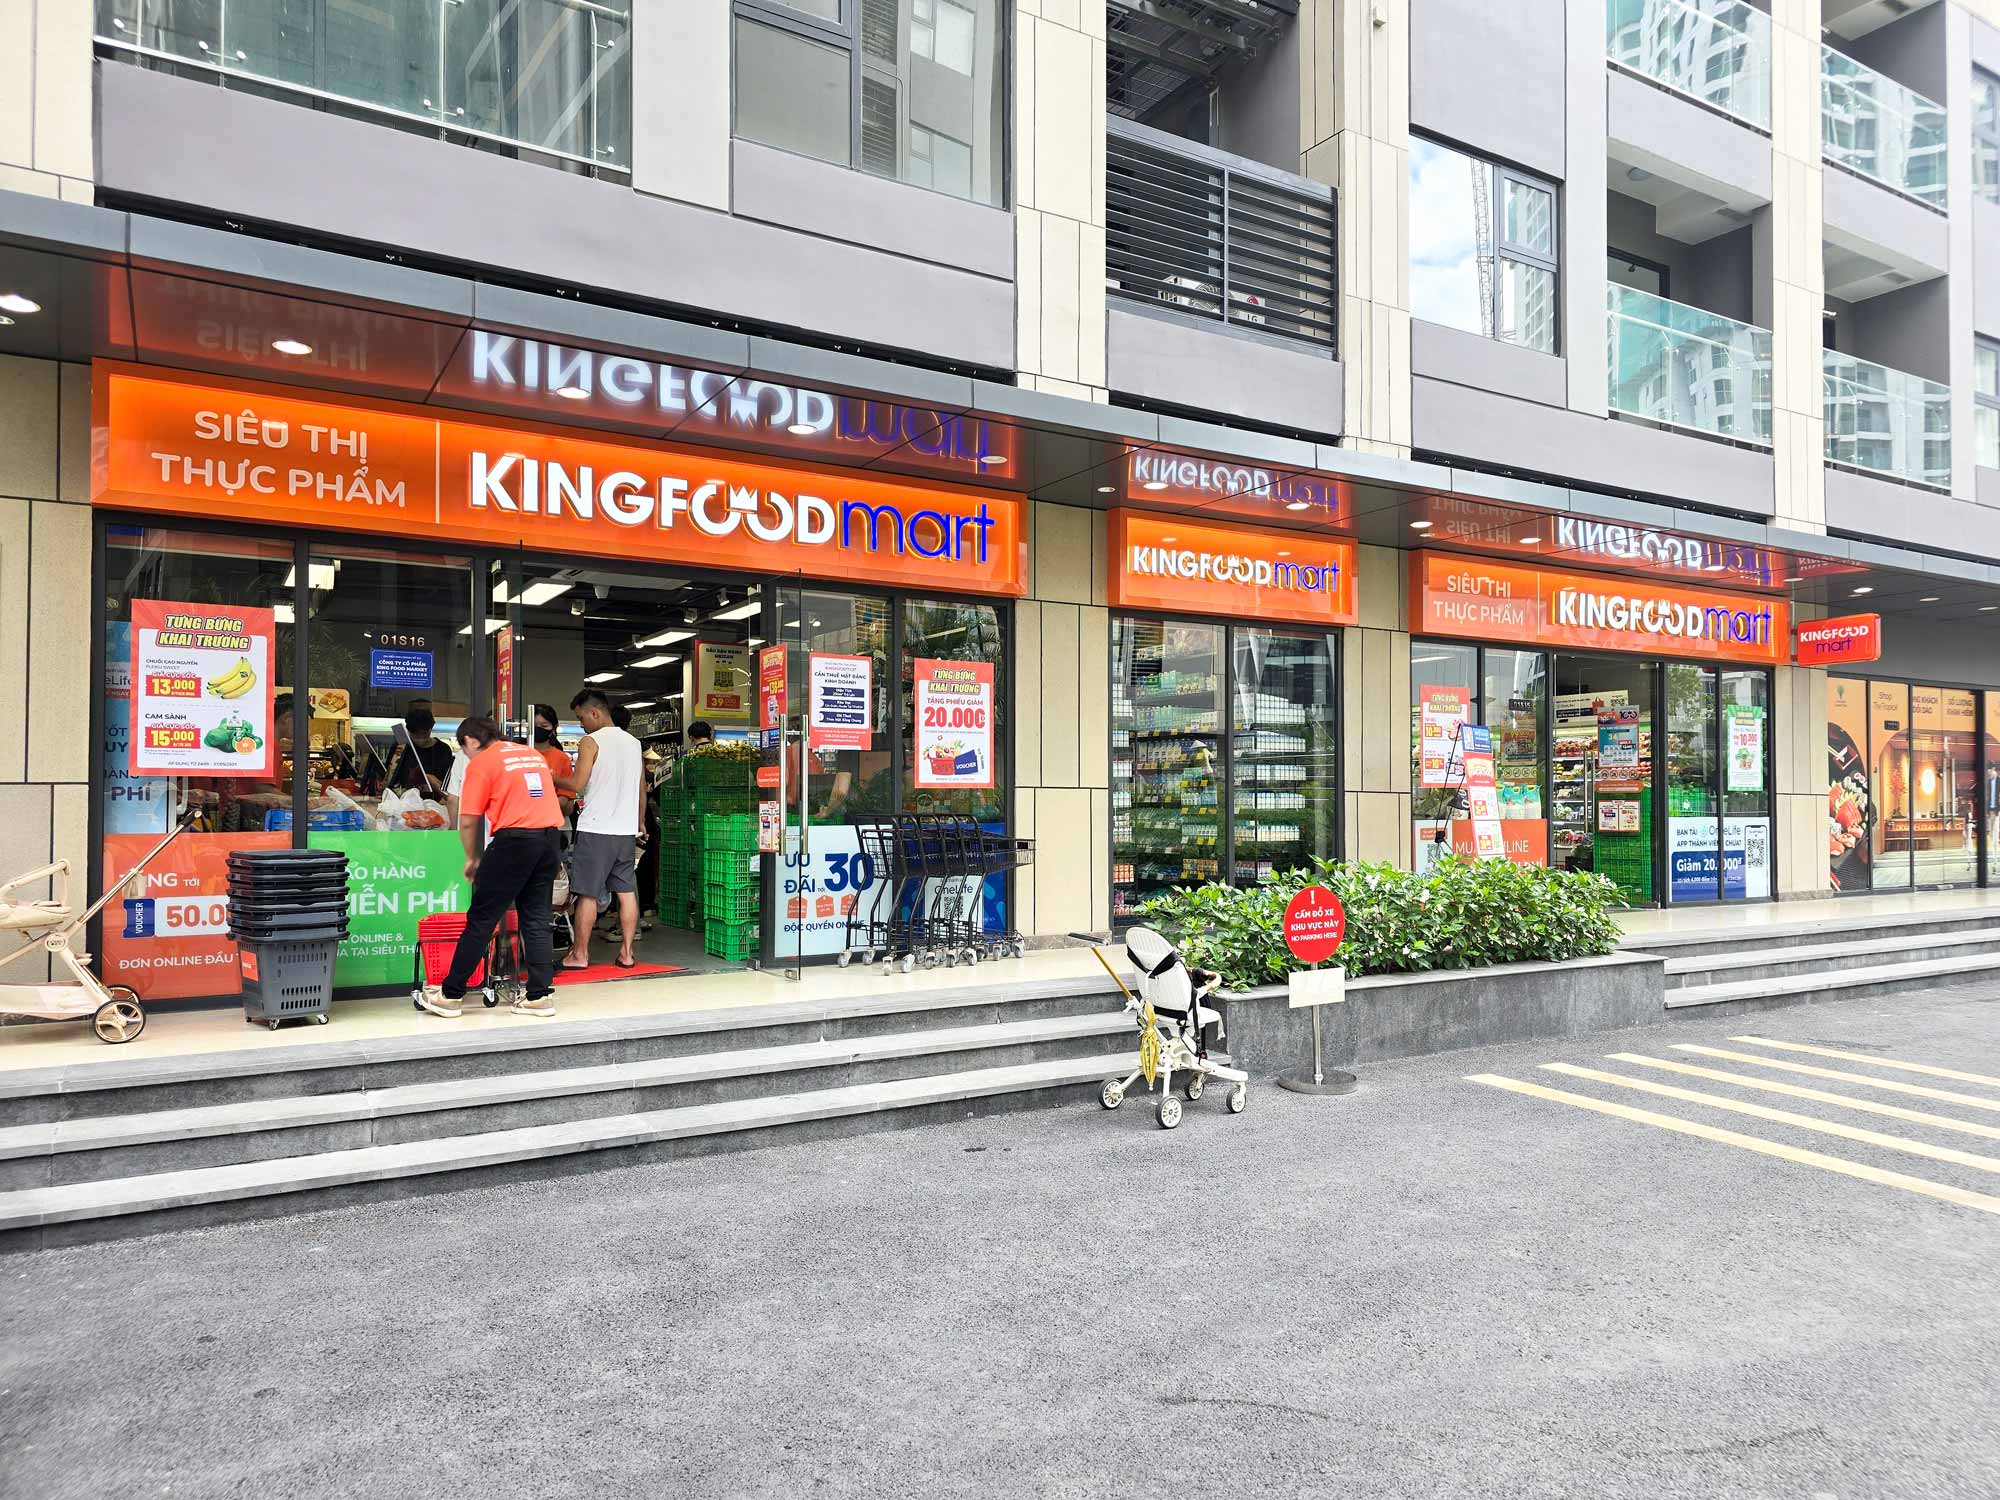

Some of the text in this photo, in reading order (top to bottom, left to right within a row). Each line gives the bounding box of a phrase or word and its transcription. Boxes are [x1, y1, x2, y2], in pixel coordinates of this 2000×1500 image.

[194, 409, 368, 465] SIÊU THỊ
[151, 452, 406, 508] THỰC PHẨM
[470, 451, 996, 563] KINGFOOD mart
[1133, 545, 1271, 585] KINGFOOD
[1447, 571, 1511, 600] SIÊU THỊ
[1433, 600, 1524, 627] THỰC PHẨM
[1559, 590, 1703, 637] KINGFOOD
[159, 632, 249, 649] KHAI TRƯƠNG
[380, 634, 425, 647] 01S16
[1800, 625, 1869, 643] KINGFOOD
[1816, 637, 1851, 654] mart
[164, 711, 187, 720] SÀNH
[785, 851, 810, 867] ƯU
[1676, 858, 1701, 872] Giảm
[372, 862, 427, 880] HÀNG
[784, 874, 816, 893] ĐÃI
[824, 852, 875, 892] 30
[408, 883, 460, 913] PHÍ
[135, 902, 144, 934] VOUCHER
[1295, 909, 1311, 919] CẤM
[1324, 908, 1335, 916] XE
[784, 922, 804, 933] ĐỘC
[1291, 923, 1306, 931] KHU
[1324, 919, 1339, 929] NÀY
[351, 932, 404, 943] ONLINE &
[1300, 933, 1323, 941] PARKING
[1323, 931, 1338, 939] HERE
[351, 947, 369, 958] TẠI
[371, 944, 397, 955] SIÊU
[119, 956, 150, 970] ĐƠN
[154, 954, 201, 968] ONLINE
